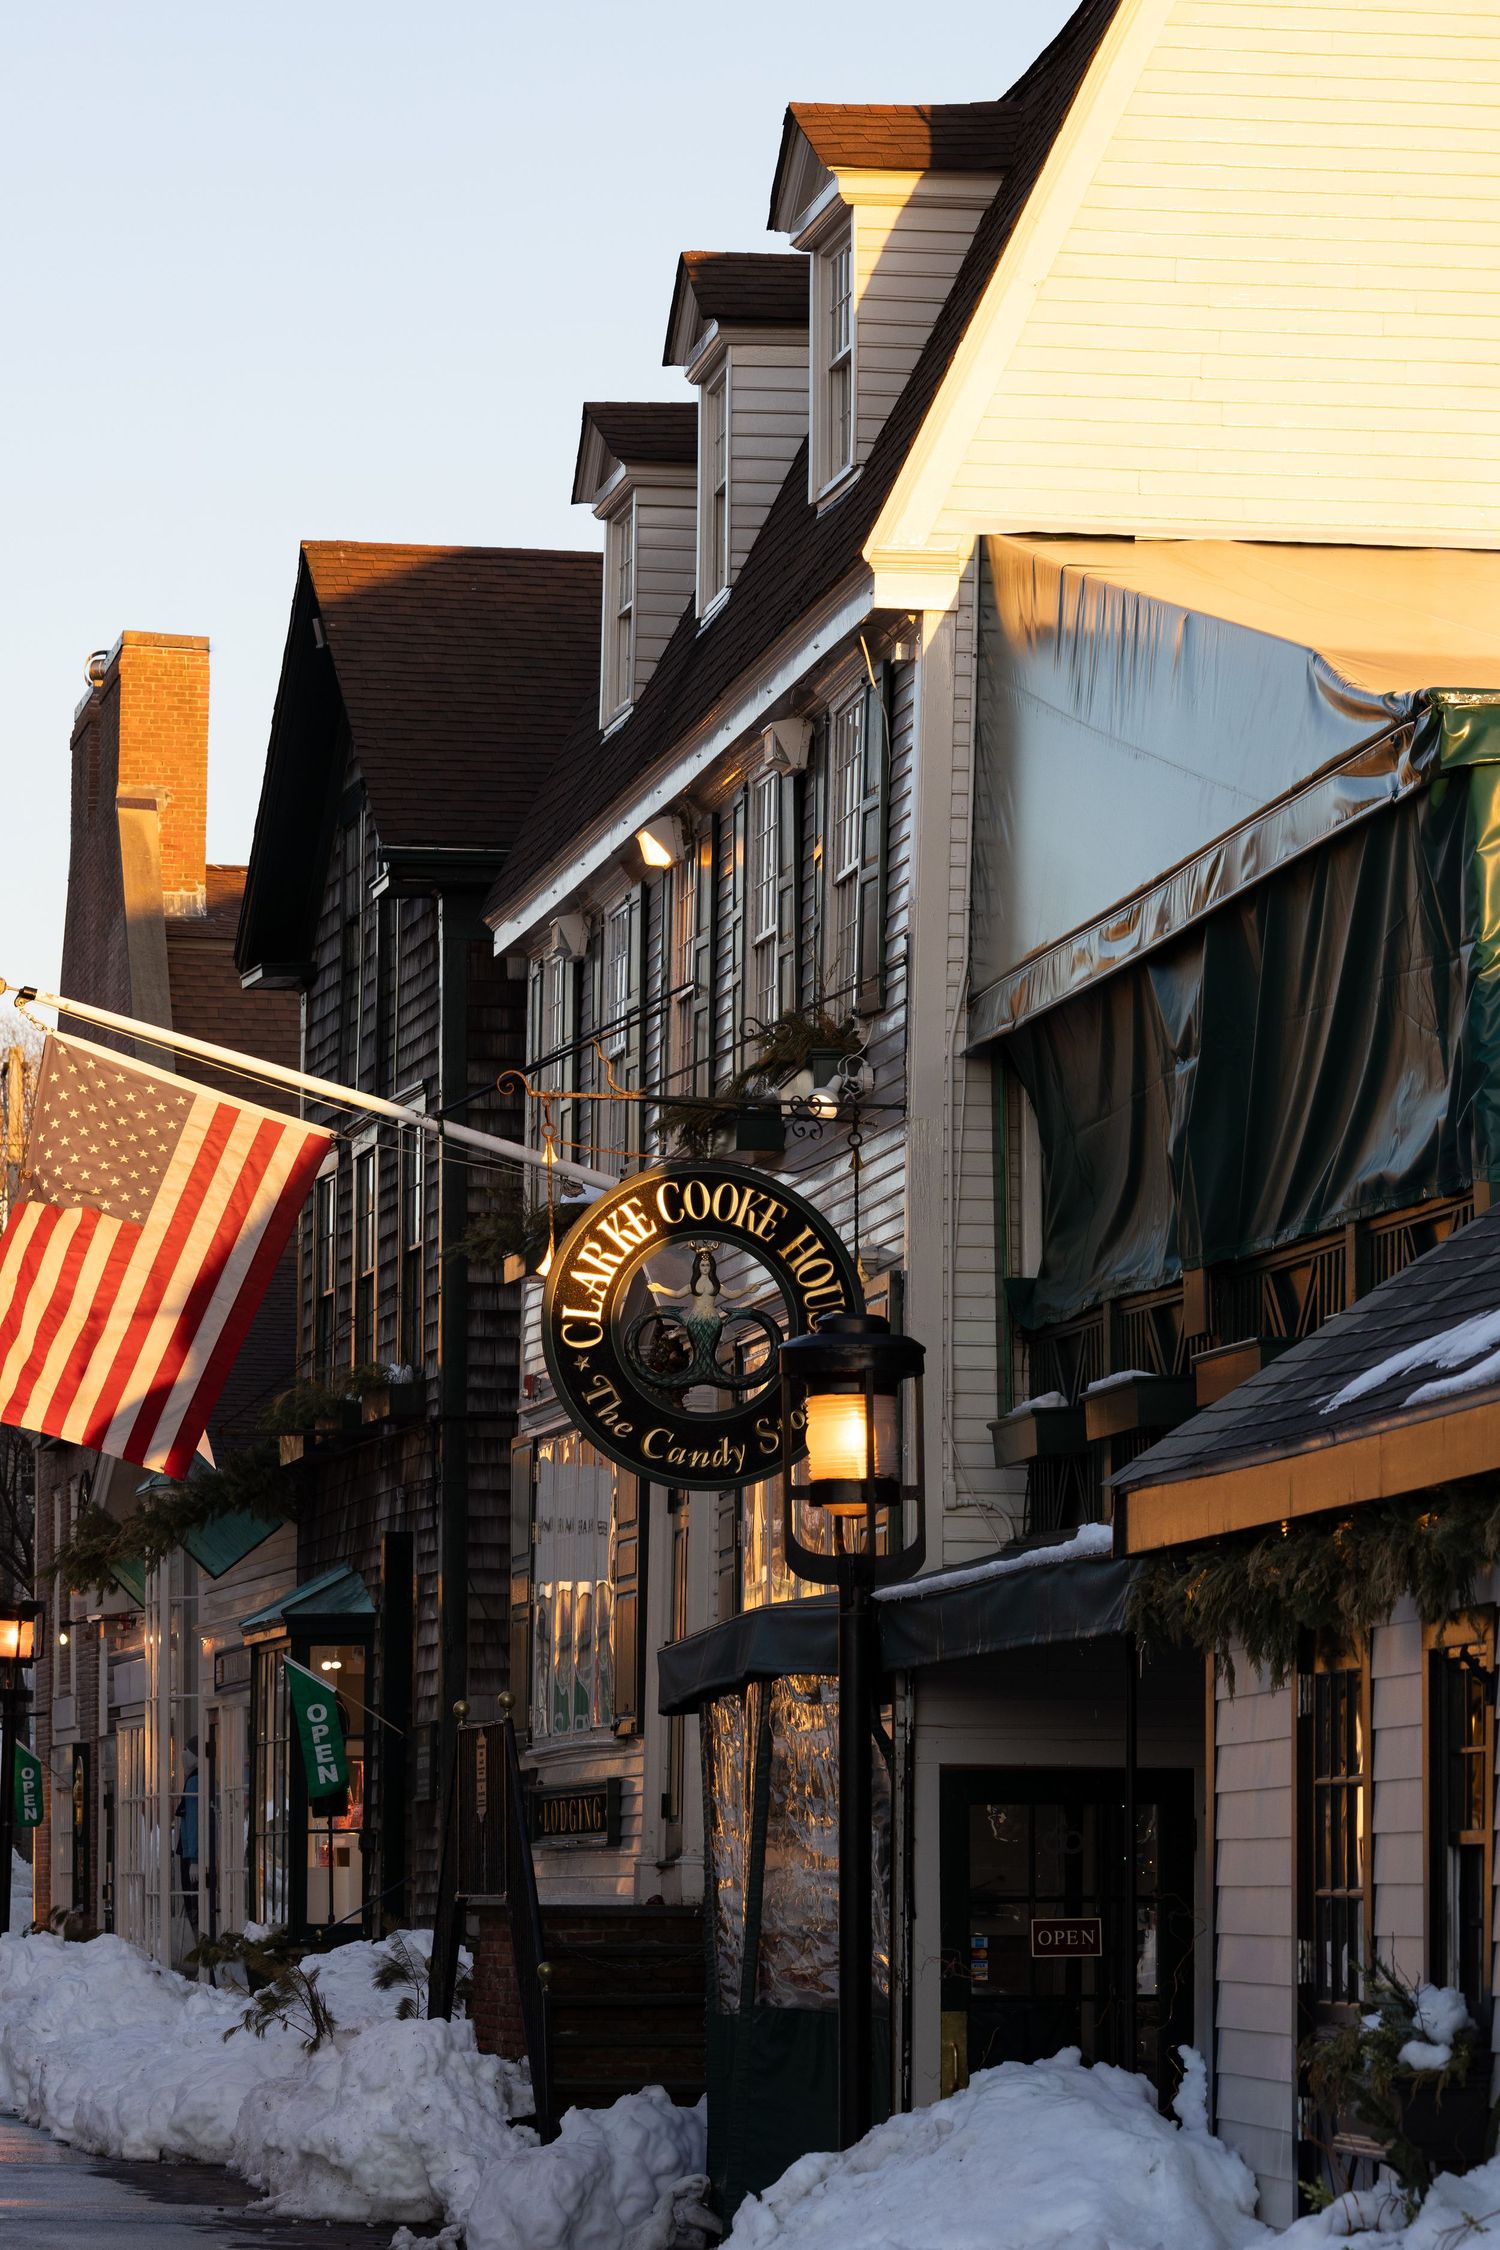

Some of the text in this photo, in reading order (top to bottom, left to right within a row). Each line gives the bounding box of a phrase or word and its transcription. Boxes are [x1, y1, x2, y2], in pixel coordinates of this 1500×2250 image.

[561, 1196, 657, 1349] CLARKE
[656, 1180, 789, 1242] COOKE
[580, 1374, 634, 1438] The
[641, 1427, 747, 1474] Candy
[306, 1703, 339, 1785] OPEN
[21, 1767, 38, 1820] OPEN
[544, 1796, 602, 1834] LODGING
[1037, 1929, 1095, 1946] OPEN
